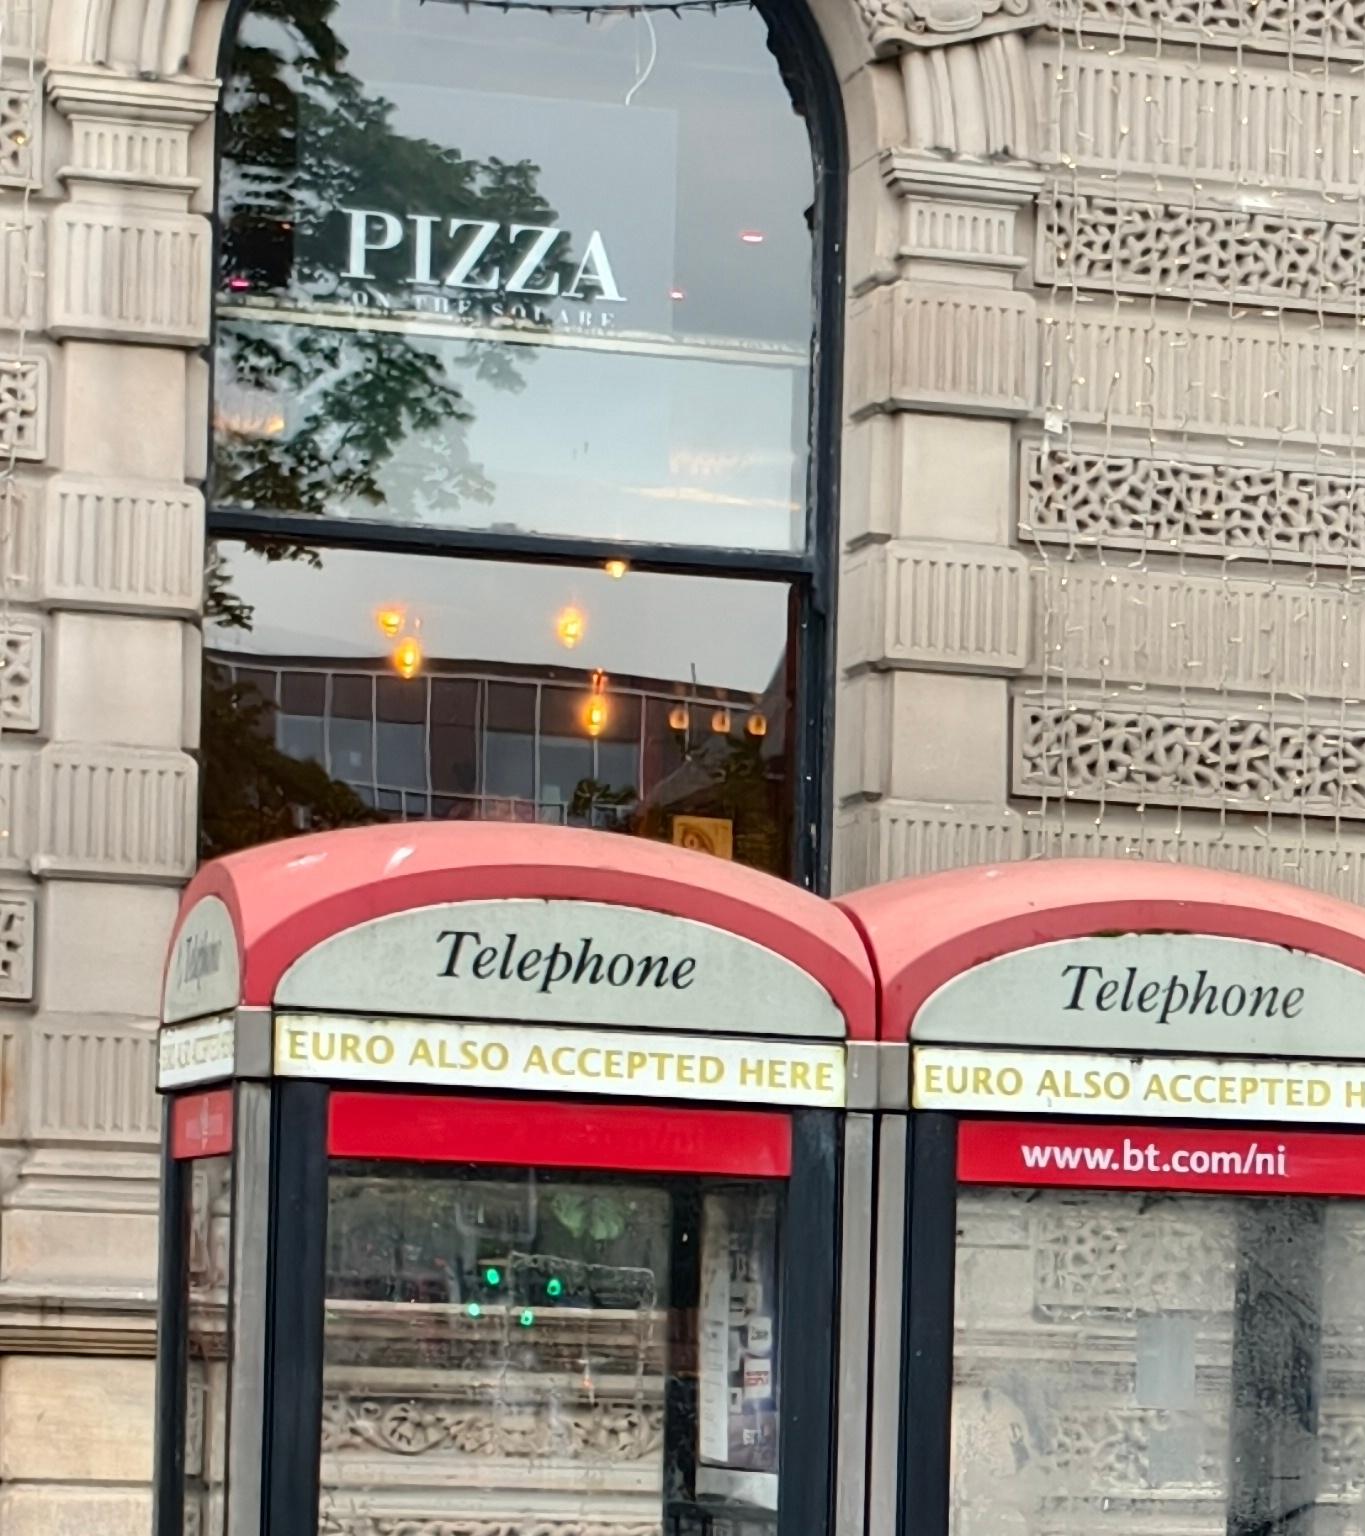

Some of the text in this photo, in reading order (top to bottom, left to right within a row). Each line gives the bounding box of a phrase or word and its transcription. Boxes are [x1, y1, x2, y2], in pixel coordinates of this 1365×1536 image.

[339, 207, 627, 302] PIZZA
[435, 930, 697, 995] Telephone
[1060, 963, 1305, 1025] Telephone
[288, 1030, 835, 1092] EURO ALSO ACCEPTED HERE
[923, 1064, 1024, 1096] EURO
[1036, 1069, 1131, 1100] ALSO
[1142, 1073, 1332, 1108] ACCEPTED
[1020, 1138, 1288, 1176] www.bt.com/ni
